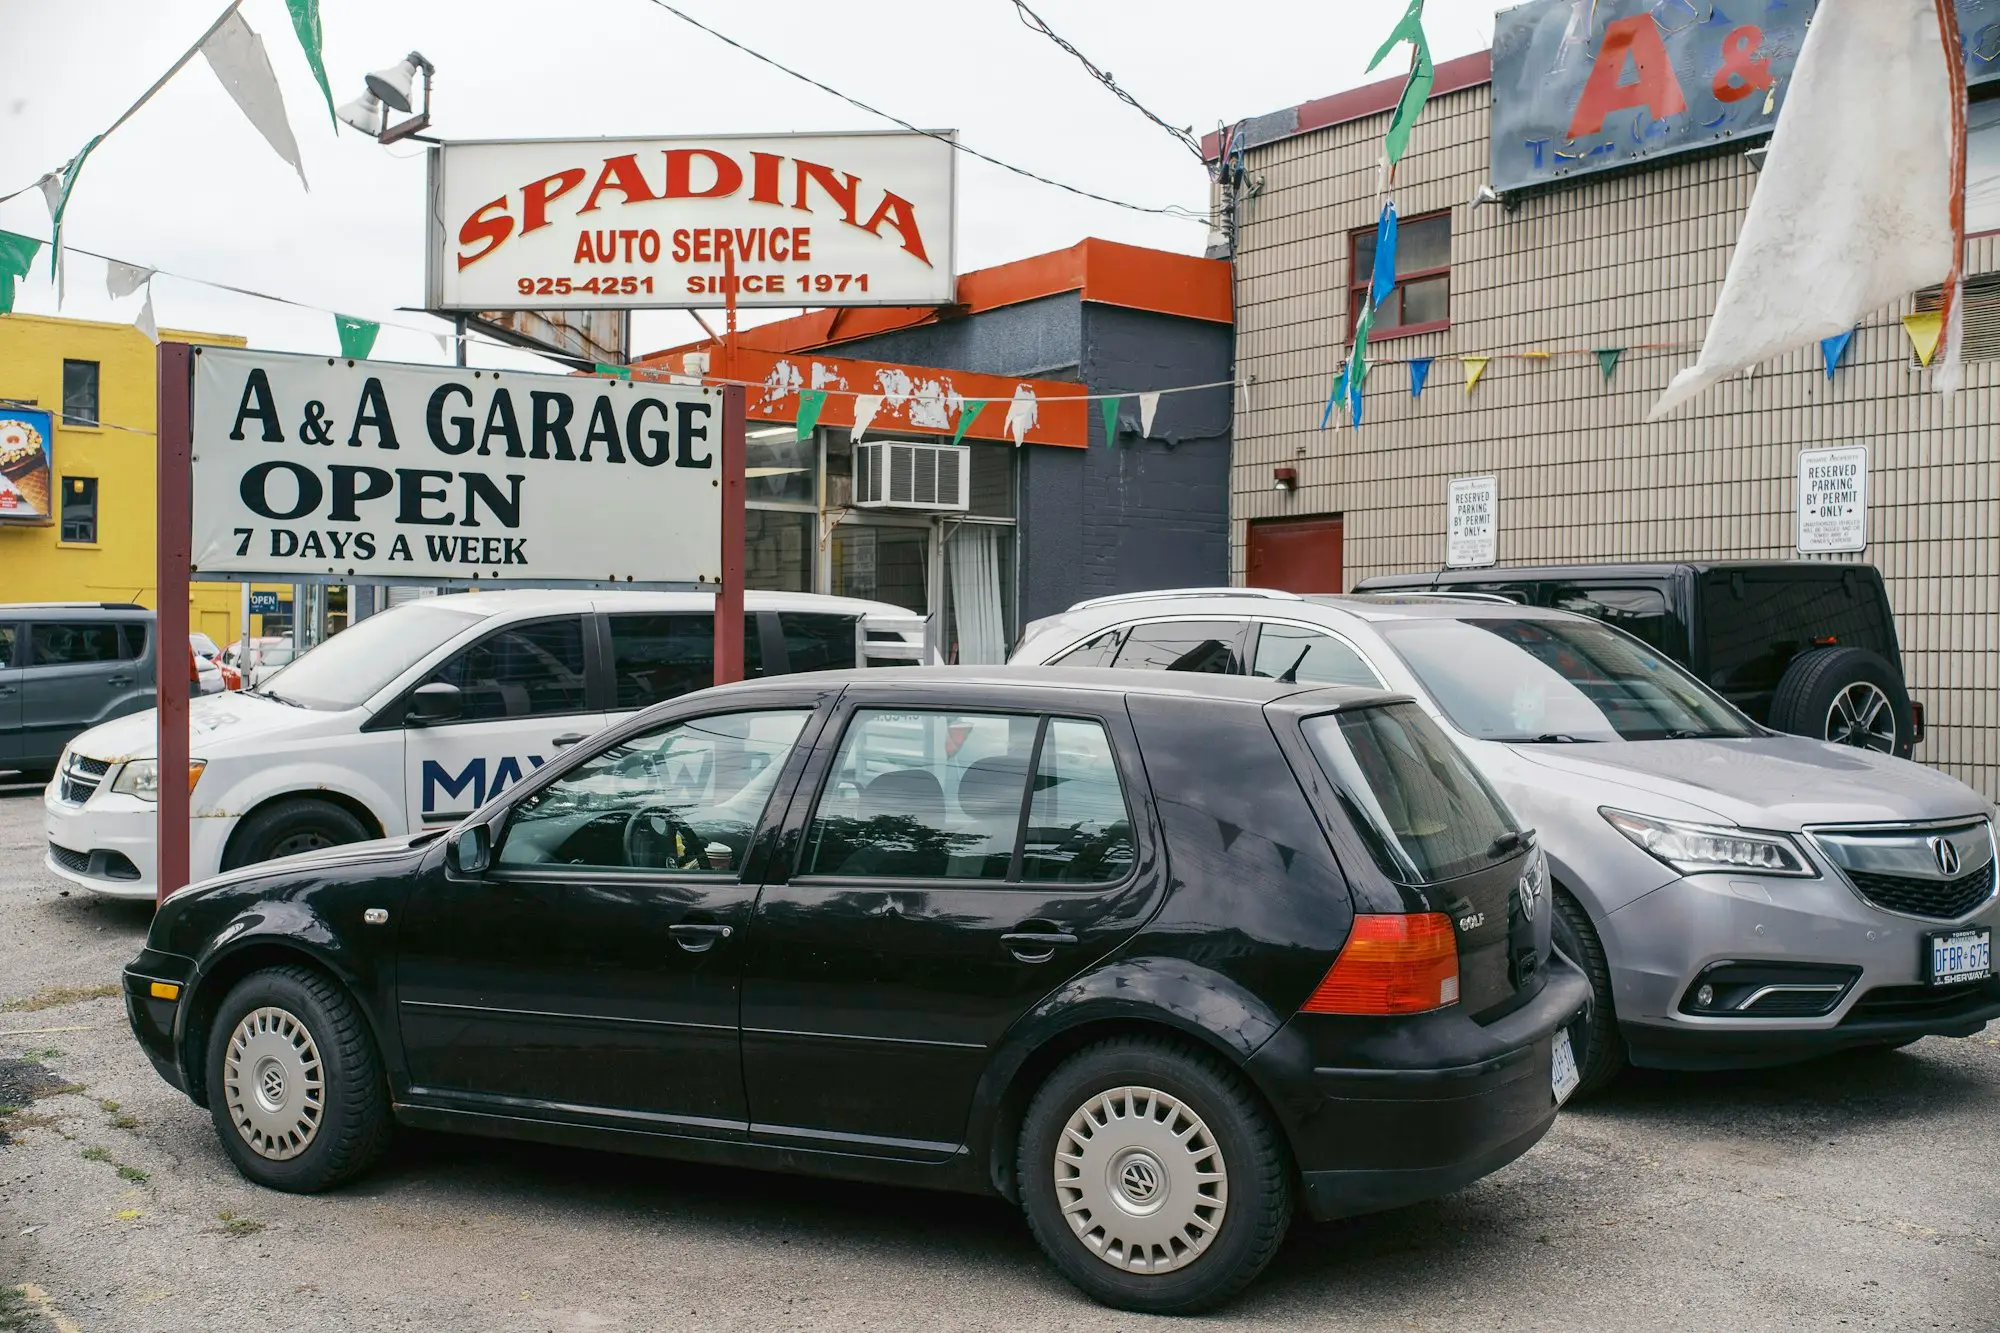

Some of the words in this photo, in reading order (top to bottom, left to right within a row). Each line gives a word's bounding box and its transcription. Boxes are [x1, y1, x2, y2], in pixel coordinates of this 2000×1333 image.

[457, 149, 933, 273] SPADINA
[574, 230, 661, 264] AUTO
[672, 227, 811, 263] SERVICE
[517, 276, 654, 296] 925-4251
[797, 273, 869, 293] 1971
[229, 368, 285, 443] A
[298, 399, 335, 447] &
[347, 377, 400, 450] A
[426, 382, 713, 470] GARAGE
[1808, 464, 1857, 478] RESERVED
[1811, 478, 1853, 491] PARKING
[239, 460, 526, 529] OPEN
[1455, 492, 1490, 504] RESERVED
[1806, 493, 1818, 505] BY
[1822, 490, 1858, 504] PERMIT
[1457, 503, 1488, 514] PARKING
[1820, 505, 1843, 518] ONLY
[1454, 516, 1462, 527] BY
[1465, 514, 1490, 525] PERMIT
[1464, 526, 1481, 537] ONLY
[233, 527, 254, 557] 7
[269, 528, 376, 561] DAYS
[387, 533, 414, 562] A
[424, 534, 529, 565] WEEK
[251, 595, 276, 605] OPEN
[1460, 913, 1485, 931] GOLF
[1944, 971, 1984, 983] SHERWAY
